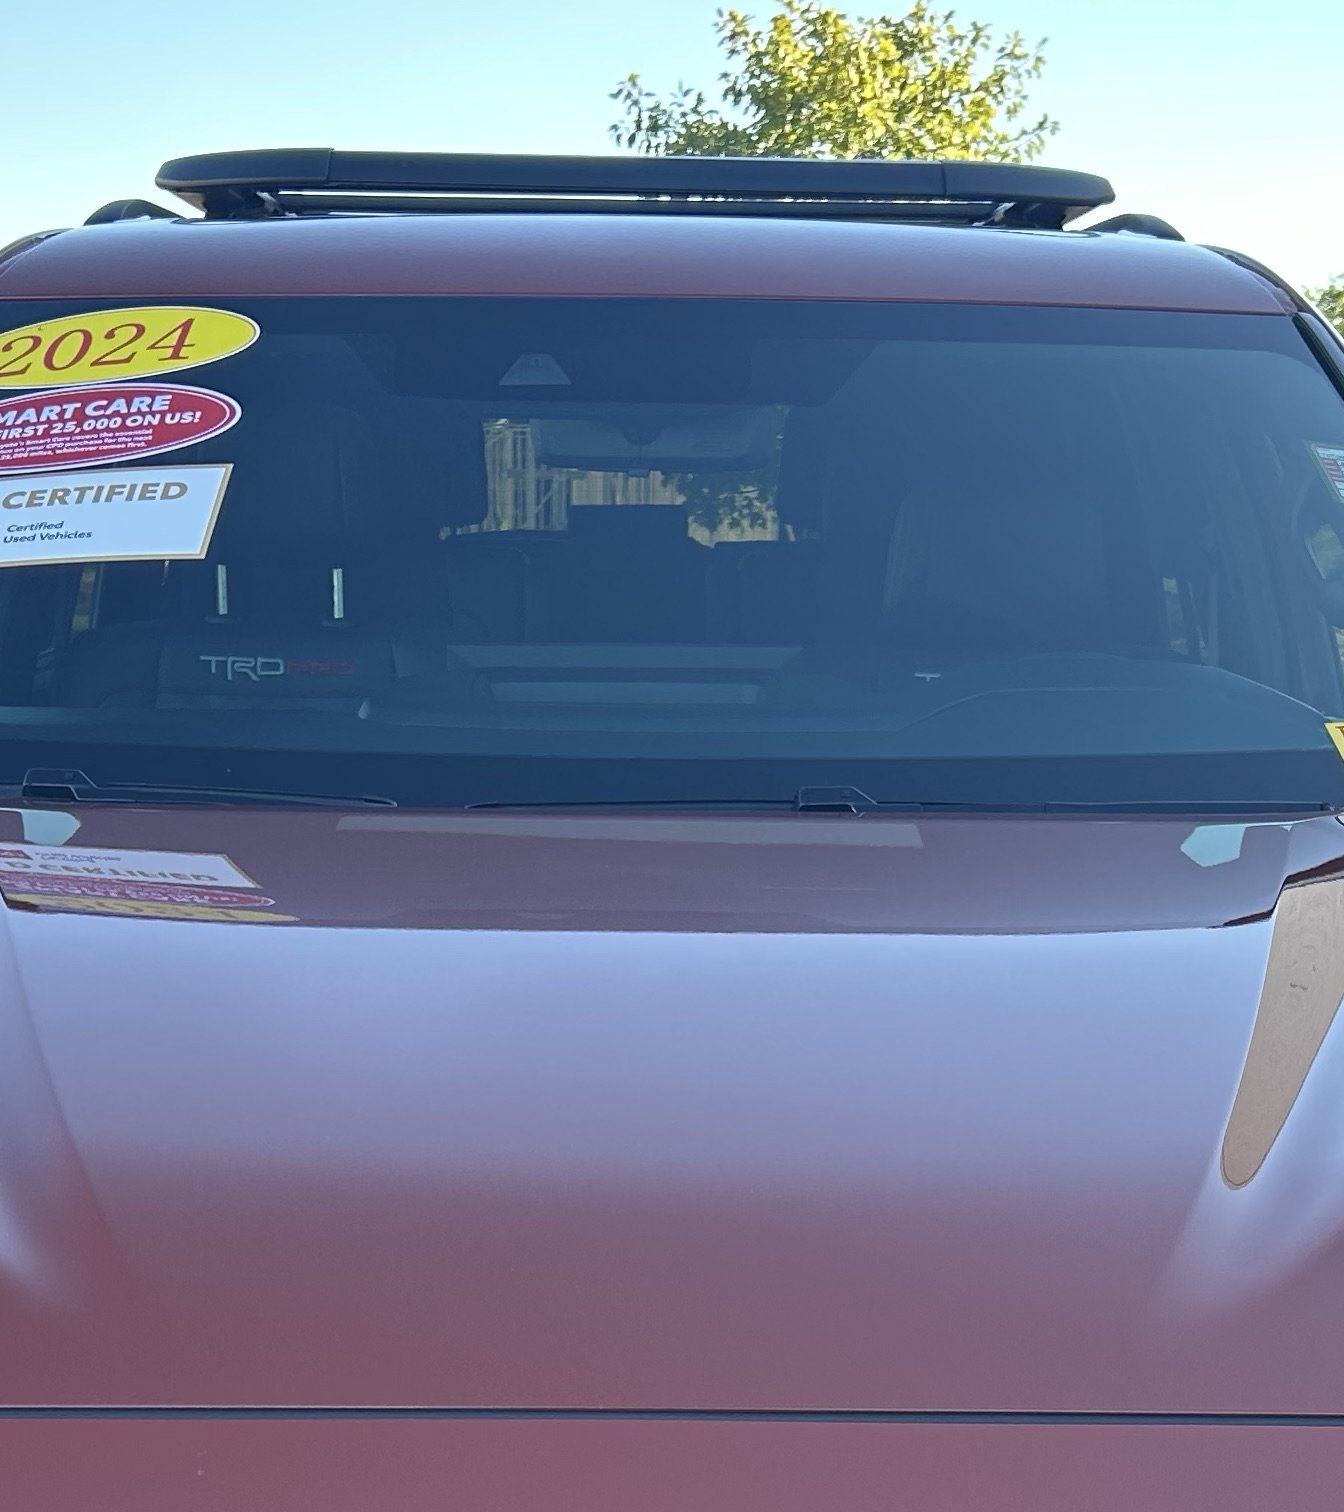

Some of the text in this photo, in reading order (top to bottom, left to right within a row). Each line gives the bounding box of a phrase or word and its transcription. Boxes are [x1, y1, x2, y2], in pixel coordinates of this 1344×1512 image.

[85, 395, 172, 417] CARE
[49, 417, 122, 434] 25,000
[125, 414, 161, 427] ON
[164, 411, 202, 424] US!
[2, 481, 188, 509] CERTIFIED
[3, 530, 92, 544] Used Vehicles
[6, 520, 64, 533] Certified
[199, 655, 284, 681] TRD
